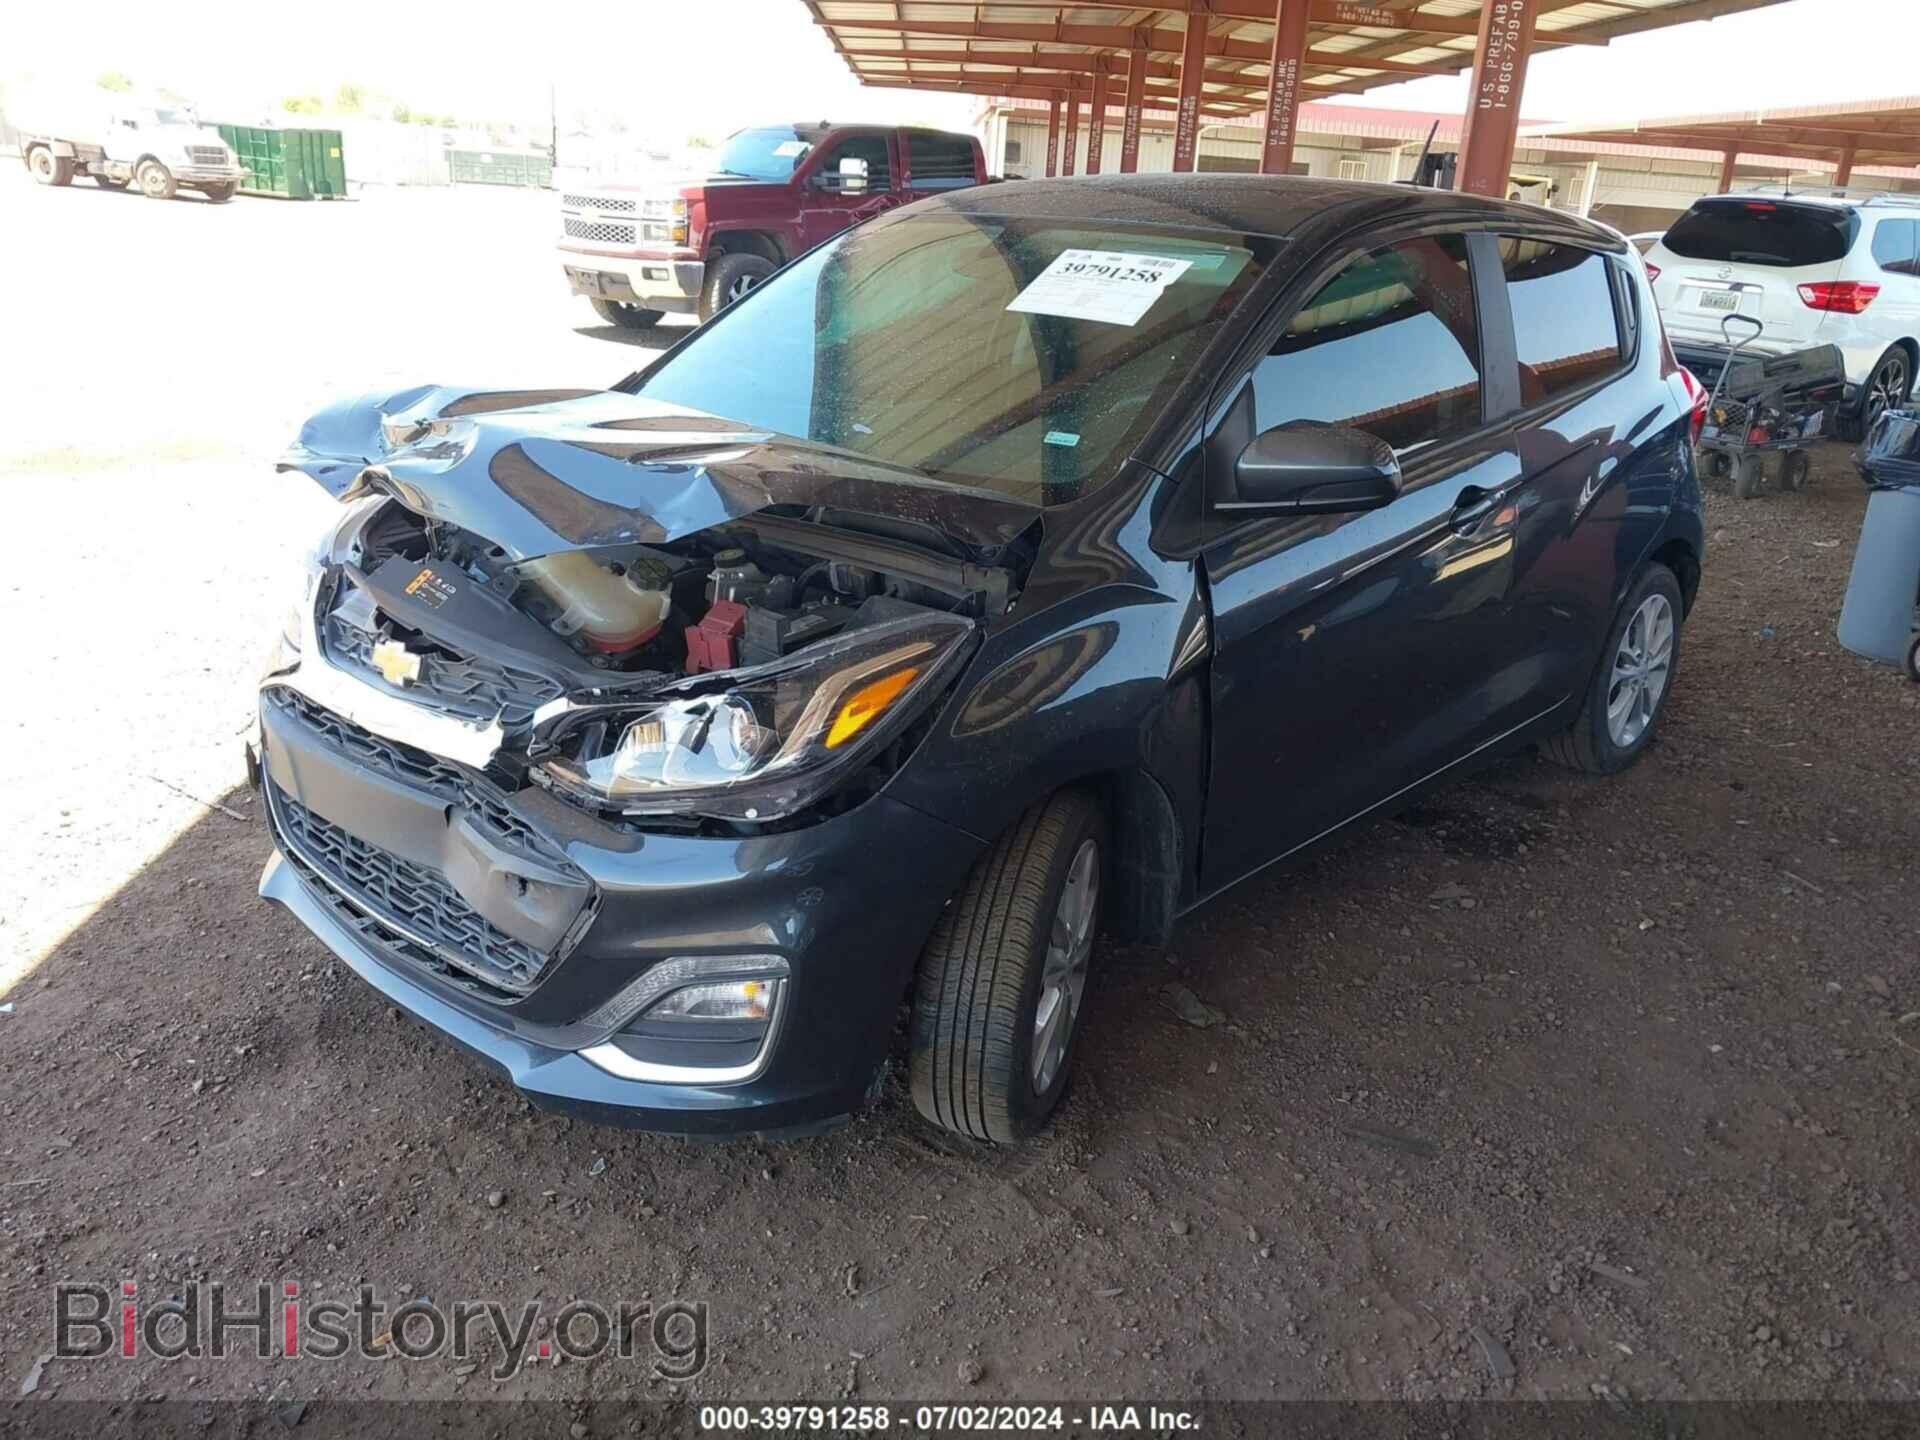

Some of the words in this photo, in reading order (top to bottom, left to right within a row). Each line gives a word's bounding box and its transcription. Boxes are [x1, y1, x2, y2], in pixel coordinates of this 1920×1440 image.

[1486, 4, 1508, 70] PREFAB
[1479, 78, 1496, 110] U.S.
[1056, 262, 1163, 283] 39791258
